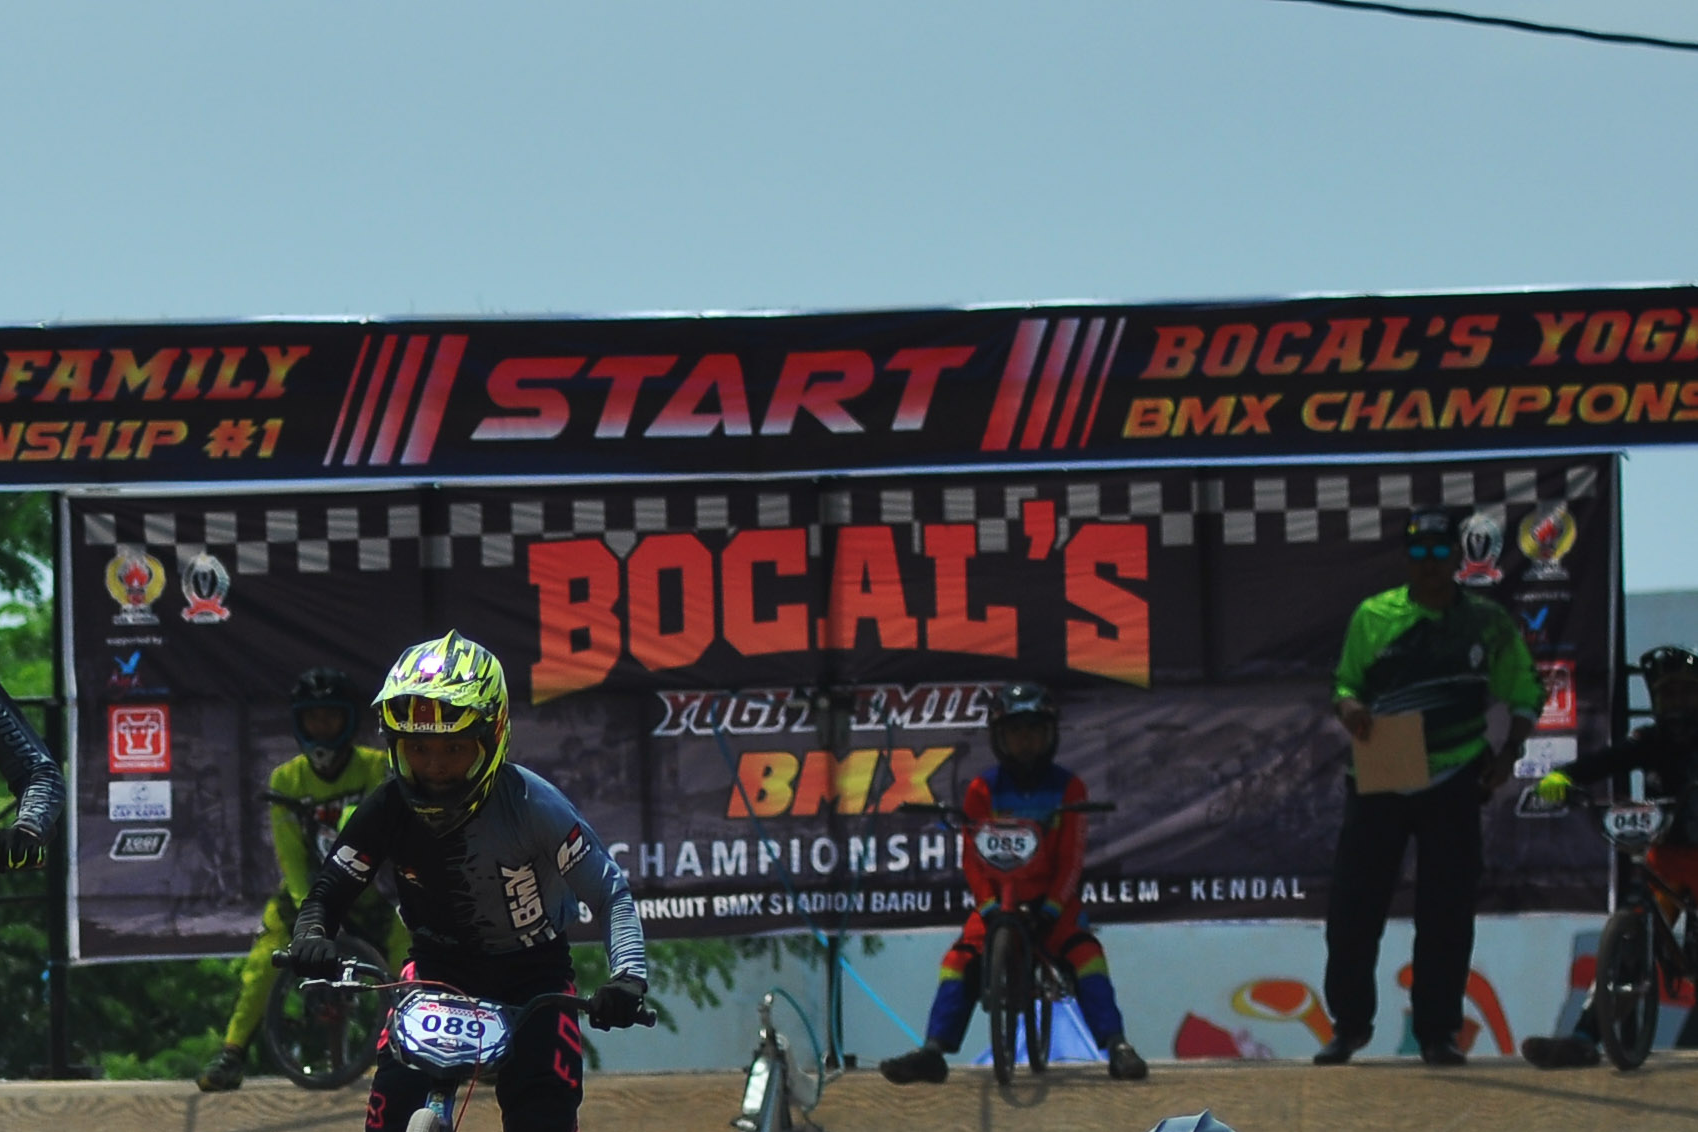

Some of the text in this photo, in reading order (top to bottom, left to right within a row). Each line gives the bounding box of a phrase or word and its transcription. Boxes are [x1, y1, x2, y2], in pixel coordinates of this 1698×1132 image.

[1139, 314, 1500, 379] BOCAL'S
[471, 346, 977, 440] START
[1121, 394, 1283, 438] BMX
[203, 418, 283, 458] #1
[528, 501, 1150, 705] BOCAL'S
[727, 748, 954, 817] BMX
[608, 834, 964, 883] CHAMPIONSHI
[635, 896, 706, 919] IRKUIT
[713, 894, 764, 917] BMX
[870, 889, 931, 913] BARU
[1191, 877, 1306, 900] KENDAL
[421, 1014, 486, 1039] 089
